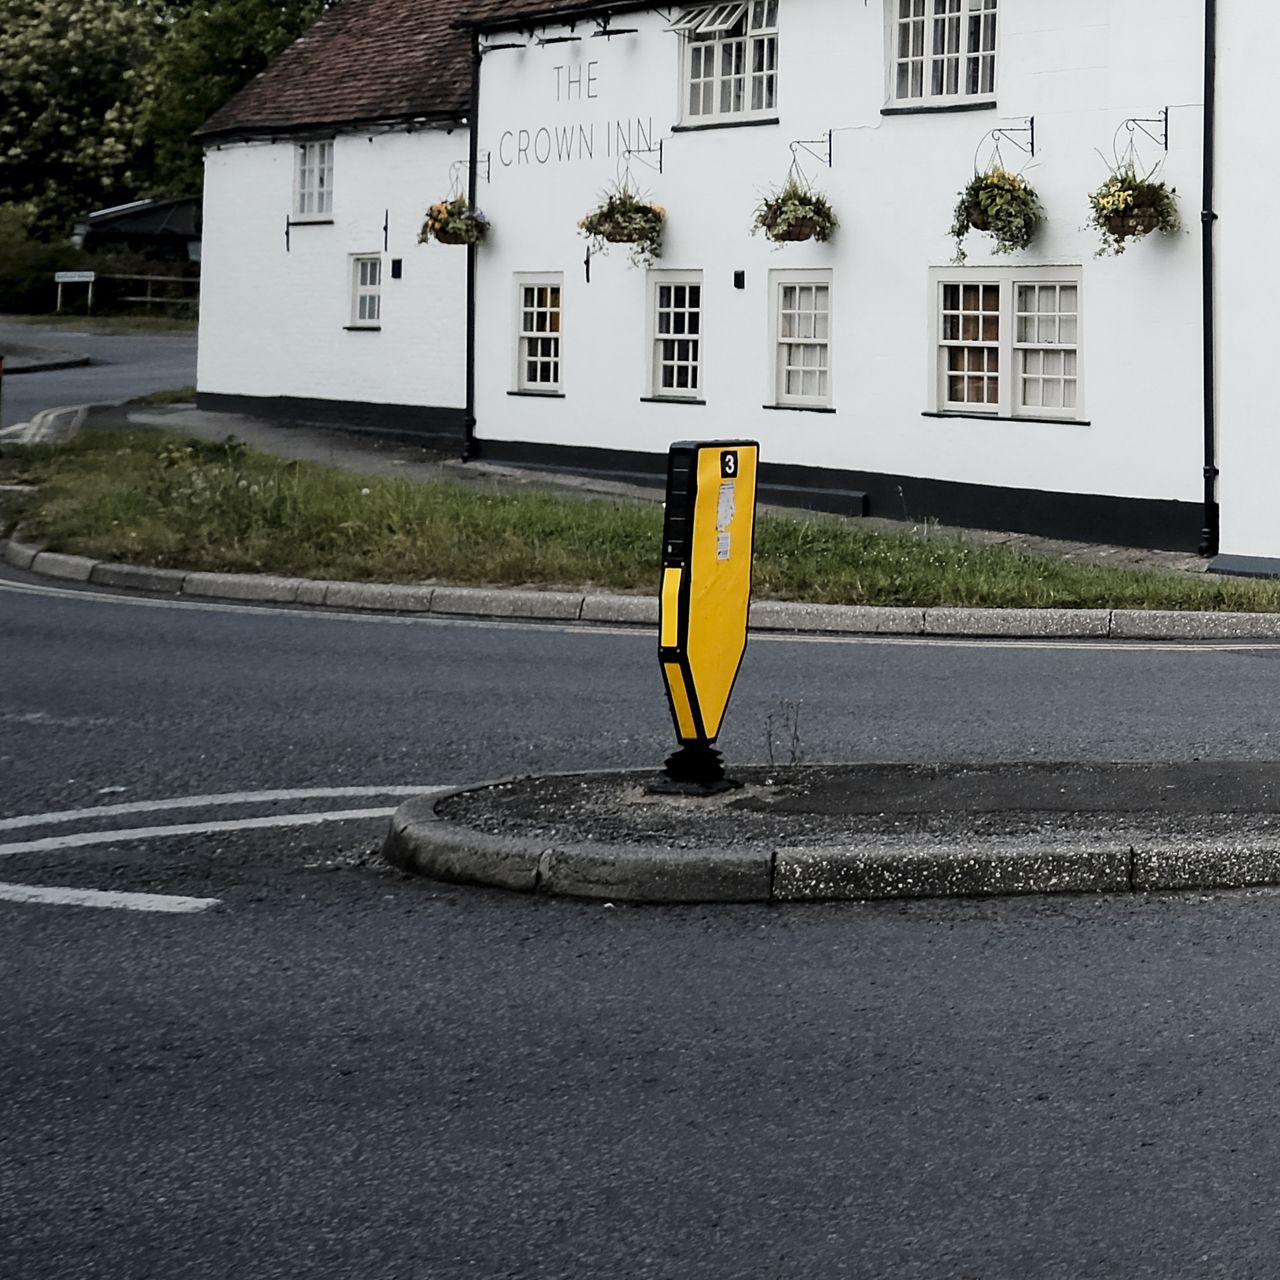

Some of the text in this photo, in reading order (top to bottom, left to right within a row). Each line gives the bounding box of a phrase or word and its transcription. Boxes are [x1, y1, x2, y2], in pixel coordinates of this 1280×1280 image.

[553, 61, 598, 102] THE
[500, 116, 652, 167] CROWN INN
[725, 454, 735, 474] 3
